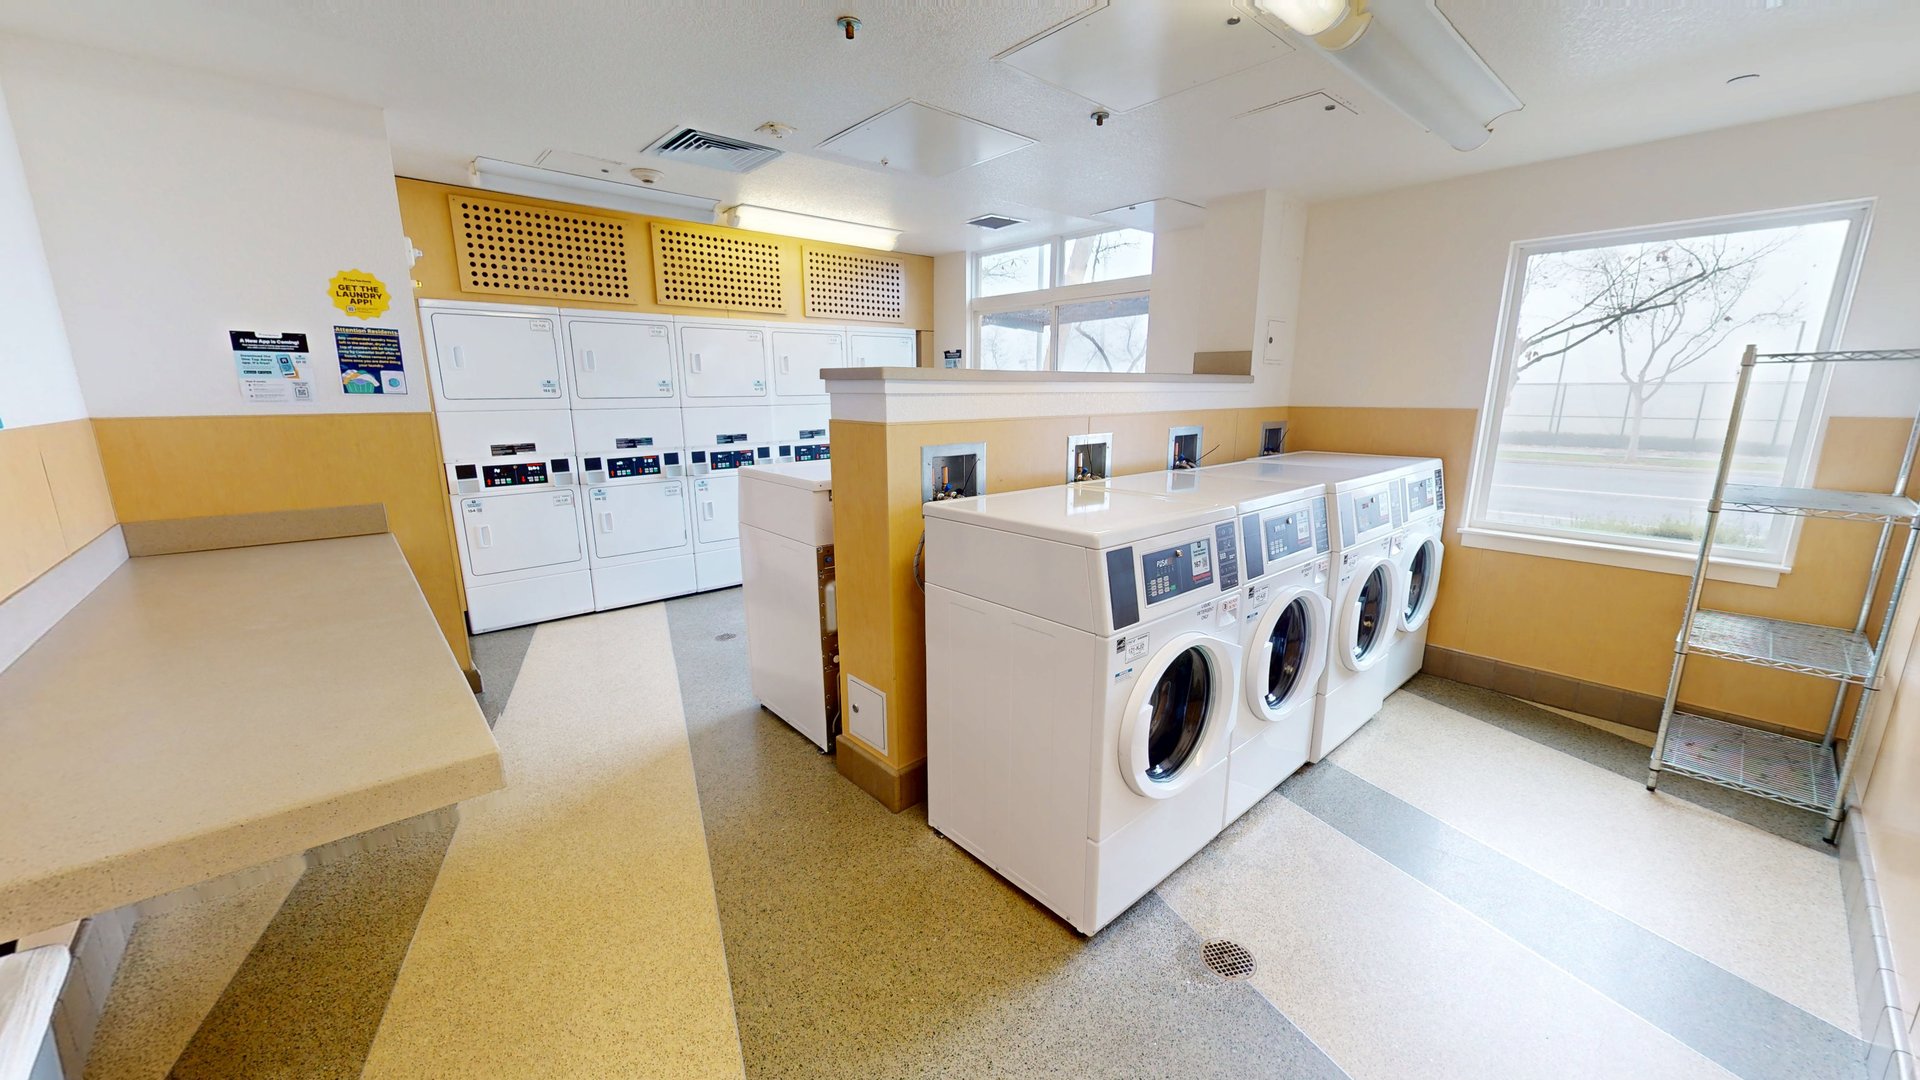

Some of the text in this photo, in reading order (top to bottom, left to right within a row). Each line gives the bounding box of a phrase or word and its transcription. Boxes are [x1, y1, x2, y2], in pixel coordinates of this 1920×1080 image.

[359, 285, 379, 293] THE
[336, 290, 382, 300] LAUNDRY
[350, 298, 373, 306] APP!
